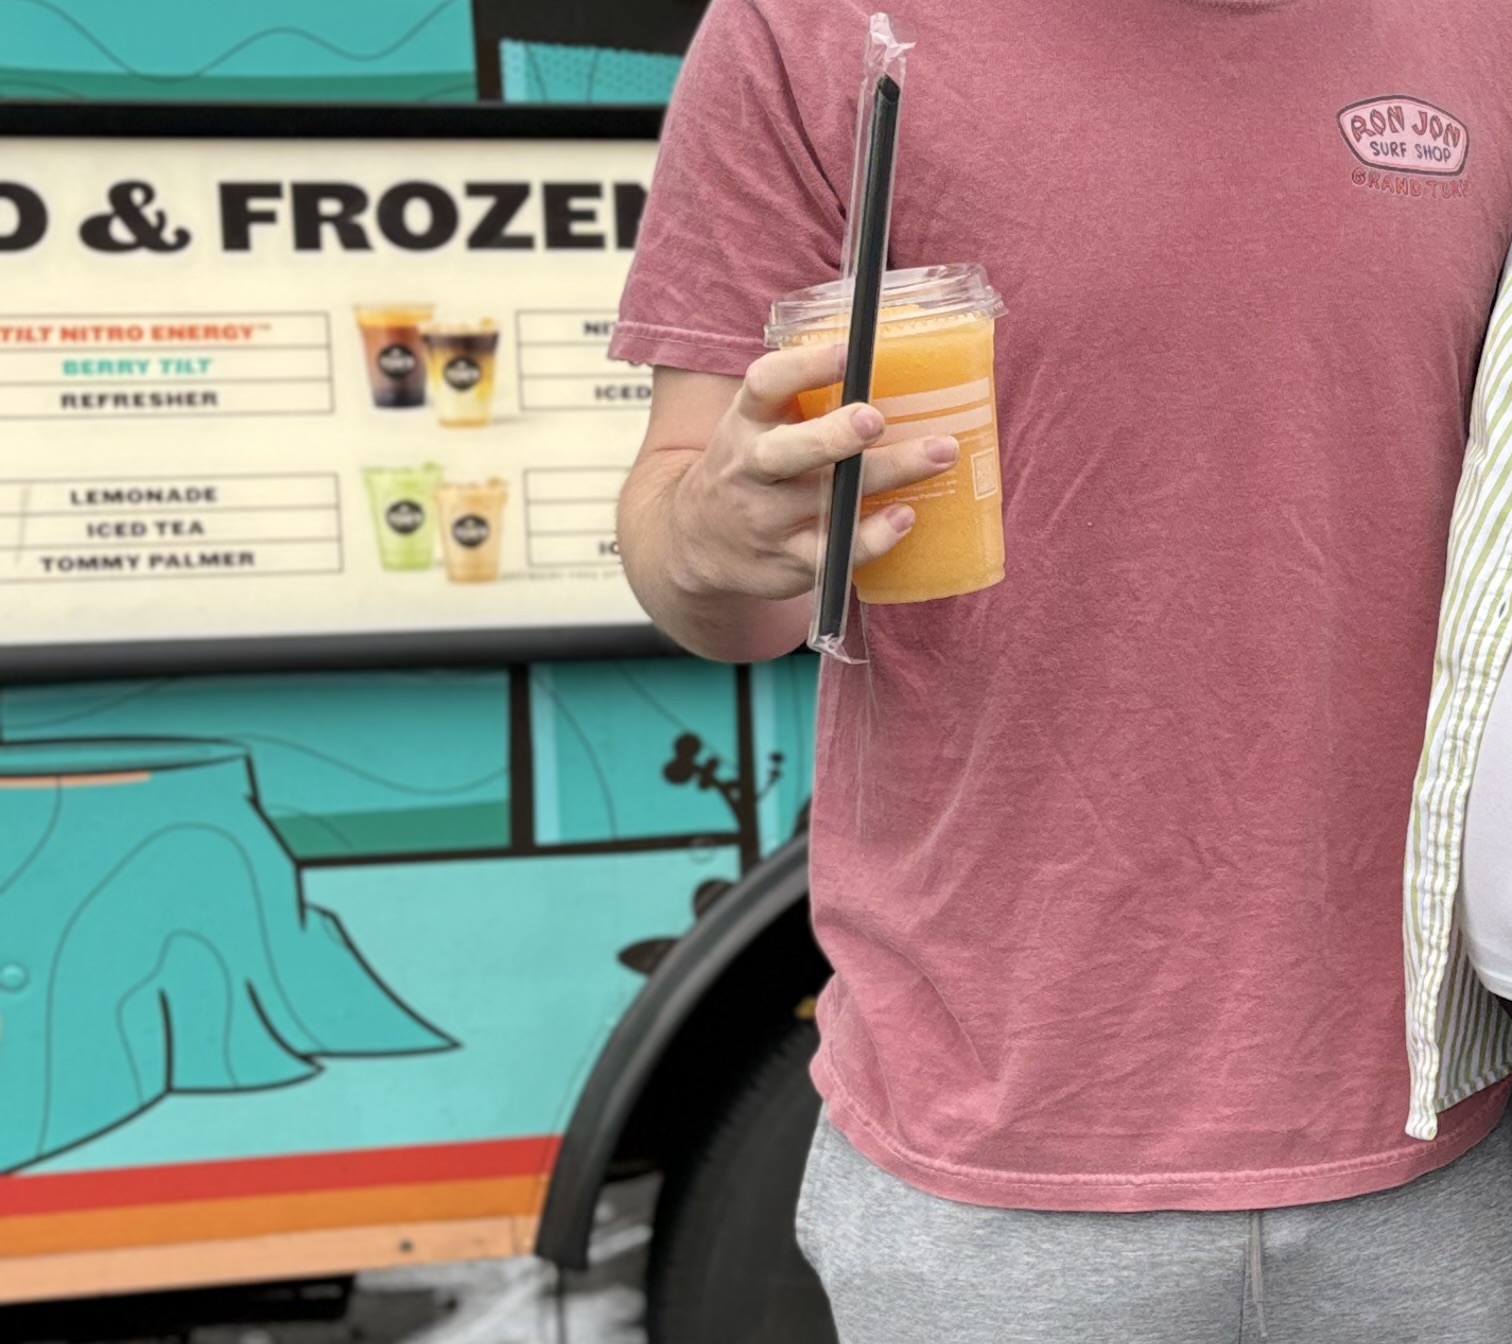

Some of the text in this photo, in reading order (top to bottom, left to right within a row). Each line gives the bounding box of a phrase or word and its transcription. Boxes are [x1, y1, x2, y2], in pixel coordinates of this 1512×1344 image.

[1351, 106, 1461, 148] RON JON
[1370, 141, 1451, 163] SURF SHOP
[1351, 167, 1422, 197] GRAND
[79, 179, 192, 254] &
[0, 325, 53, 343] TILT
[60, 324, 144, 342] NITRO
[63, 358, 213, 376] BERRY TILT
[61, 391, 218, 409] REFRESHER
[595, 384, 652, 400] ICED
[70, 487, 218, 506] LEMONADE
[87, 521, 205, 538] ICED TEA
[40, 551, 256, 572] TOMMY PALMER
